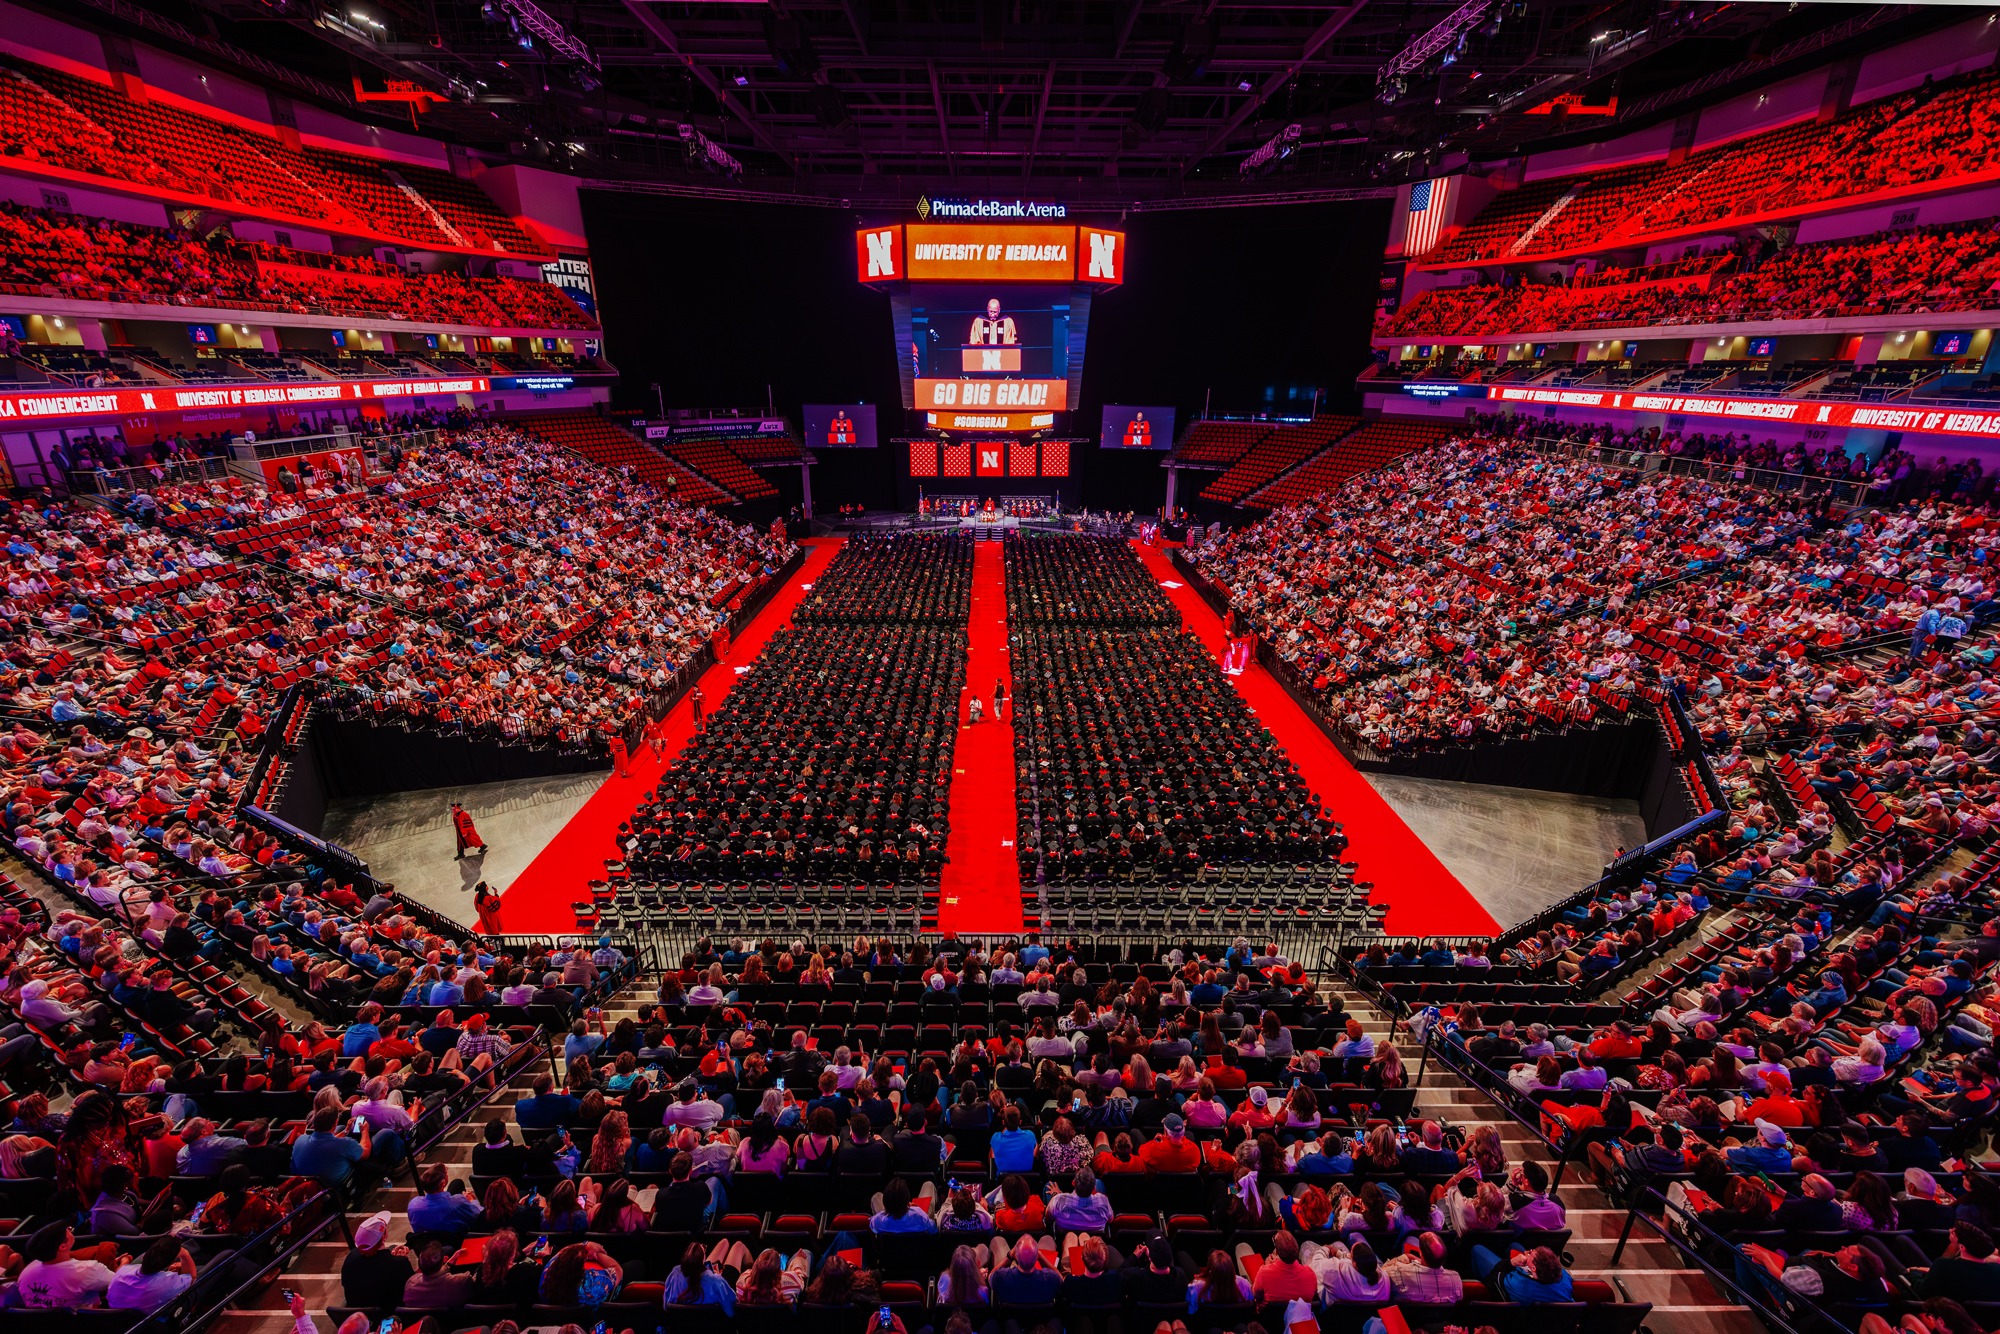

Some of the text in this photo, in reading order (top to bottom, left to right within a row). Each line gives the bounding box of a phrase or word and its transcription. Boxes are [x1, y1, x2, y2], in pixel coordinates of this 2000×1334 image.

[43, 193, 69, 207] 219
[933, 200, 1066, 217] PinnacleBank Arena
[1891, 213, 1915, 225] 204
[866, 231, 895, 277] N
[915, 244, 1067, 261] UNIVERSITY OF NEBRASKA
[1088, 232, 1116, 278] N
[499, 265, 514, 273] 222
[546, 274, 591, 294] WITH
[1461, 275, 1476, 283] 201
[982, 350, 1001, 370] N
[175, 386, 341, 407] UNIVERSITY OF NEBRASKA COMMENCEMENT
[372, 381, 473, 396] UNIVERSITY OF NEBRASKA COMMENCEMENT
[933, 383, 1048, 405] GO BIG GRAD!
[1502, 388, 1603, 405] UNIVERSITY OF NEBRASKA COMMENCEMENT
[18, 395, 118, 416] COMMENCEMENT
[141, 392, 157, 410] N
[1632, 396, 1799, 419] UNIVERSITY OF NEBRASKA COMMENCEMENT
[208, 411, 221, 420] Club
[221, 411, 241, 421] Lounge
[280, 407, 295, 417] 118
[1816, 405, 1833, 422] N
[1850, 408, 1925, 428] UNIVERSITY
[1922, 412, 1945, 430] OF
[127, 417, 148, 429] 117
[954, 415, 1008, 428] #GOBIGGRAD
[1670, 418, 1685, 427] 106
[1132, 435, 1142, 445] N
[1807, 429, 1828, 440] 107
[982, 451, 998, 468] N
